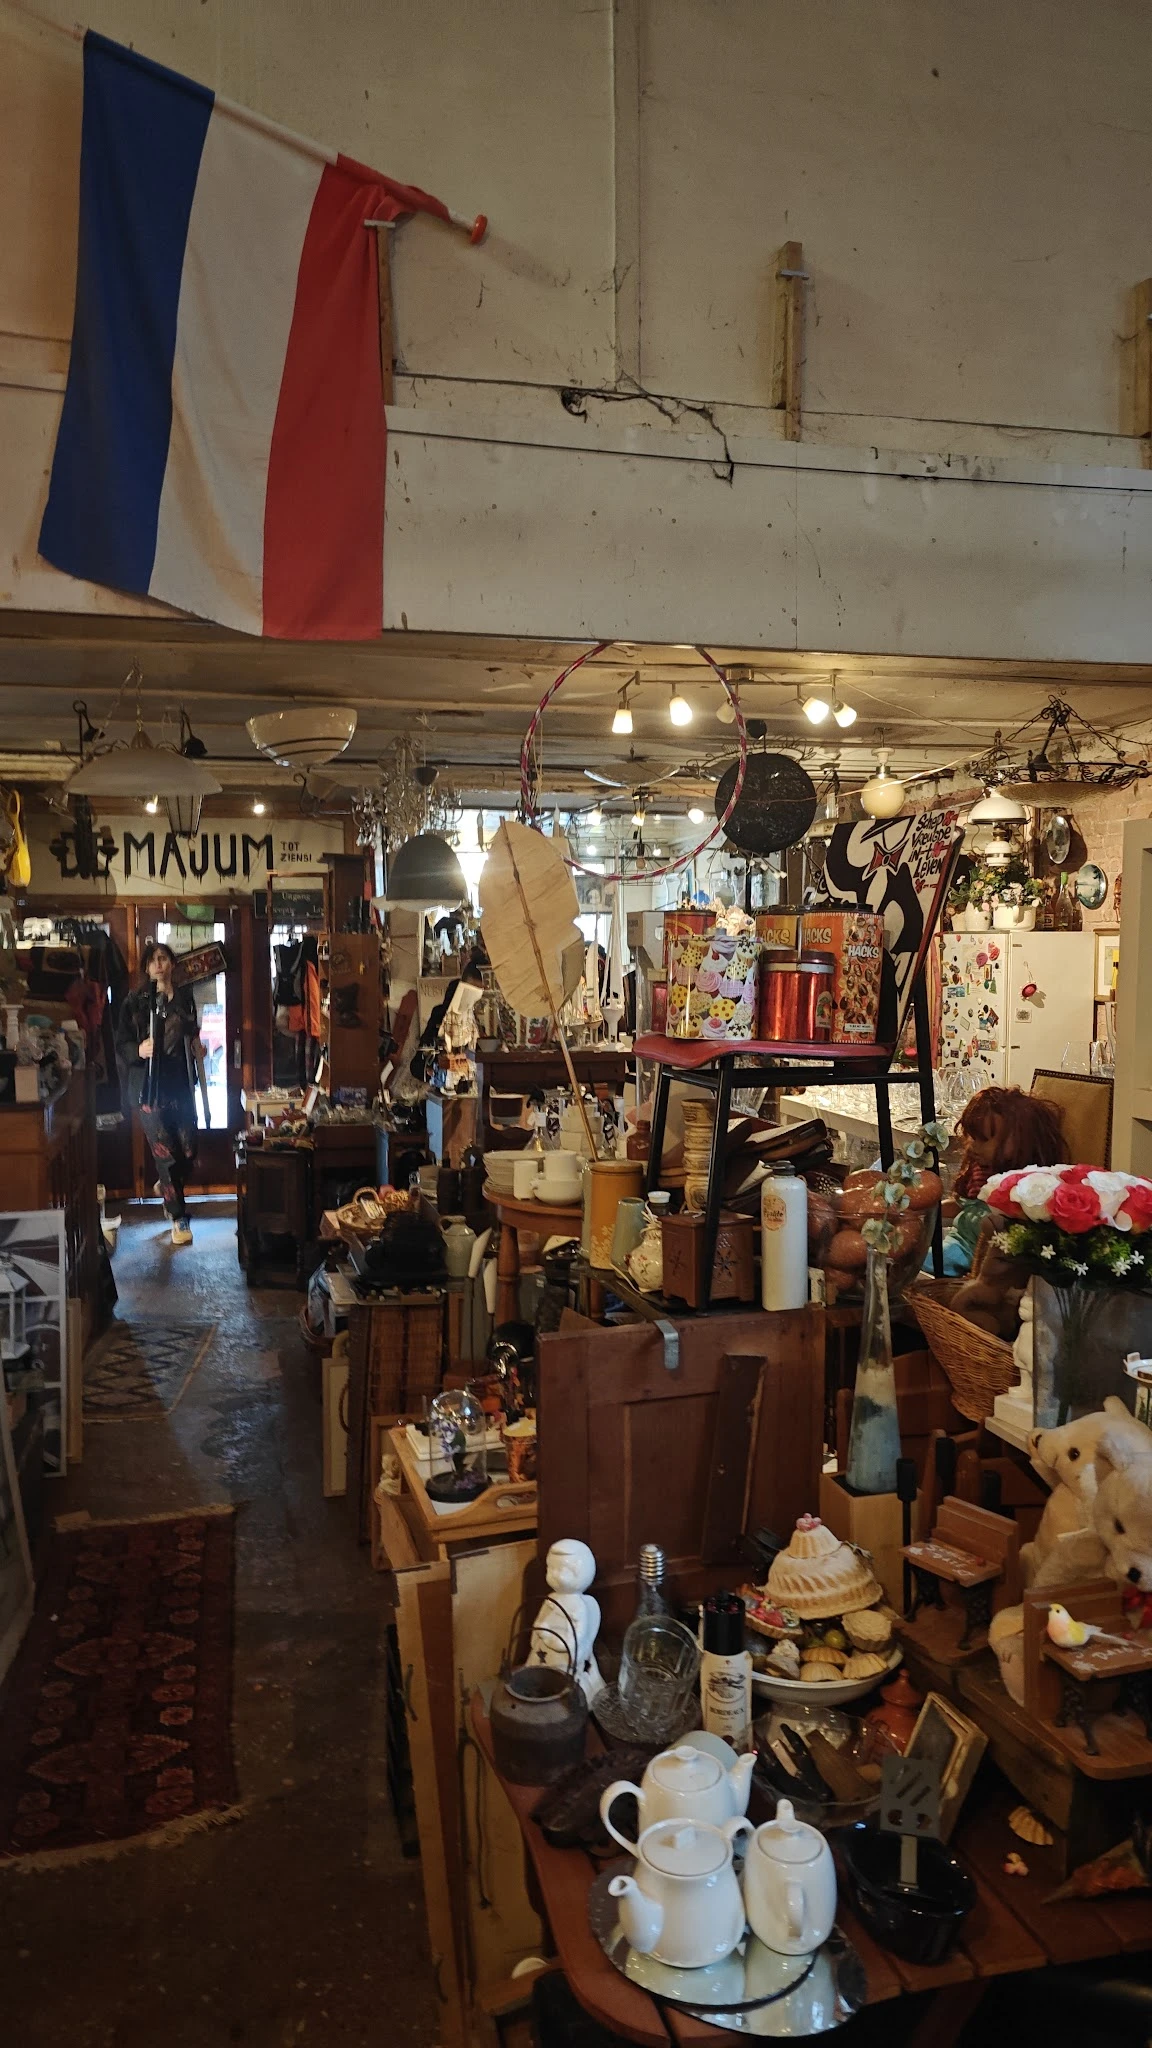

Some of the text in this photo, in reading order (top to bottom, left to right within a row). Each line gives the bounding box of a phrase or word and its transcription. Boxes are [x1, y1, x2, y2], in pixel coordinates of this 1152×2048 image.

[280, 841, 300, 852] TOT
[123, 832, 275, 880] MAJUM
[848, 945, 880, 958] HACKS
